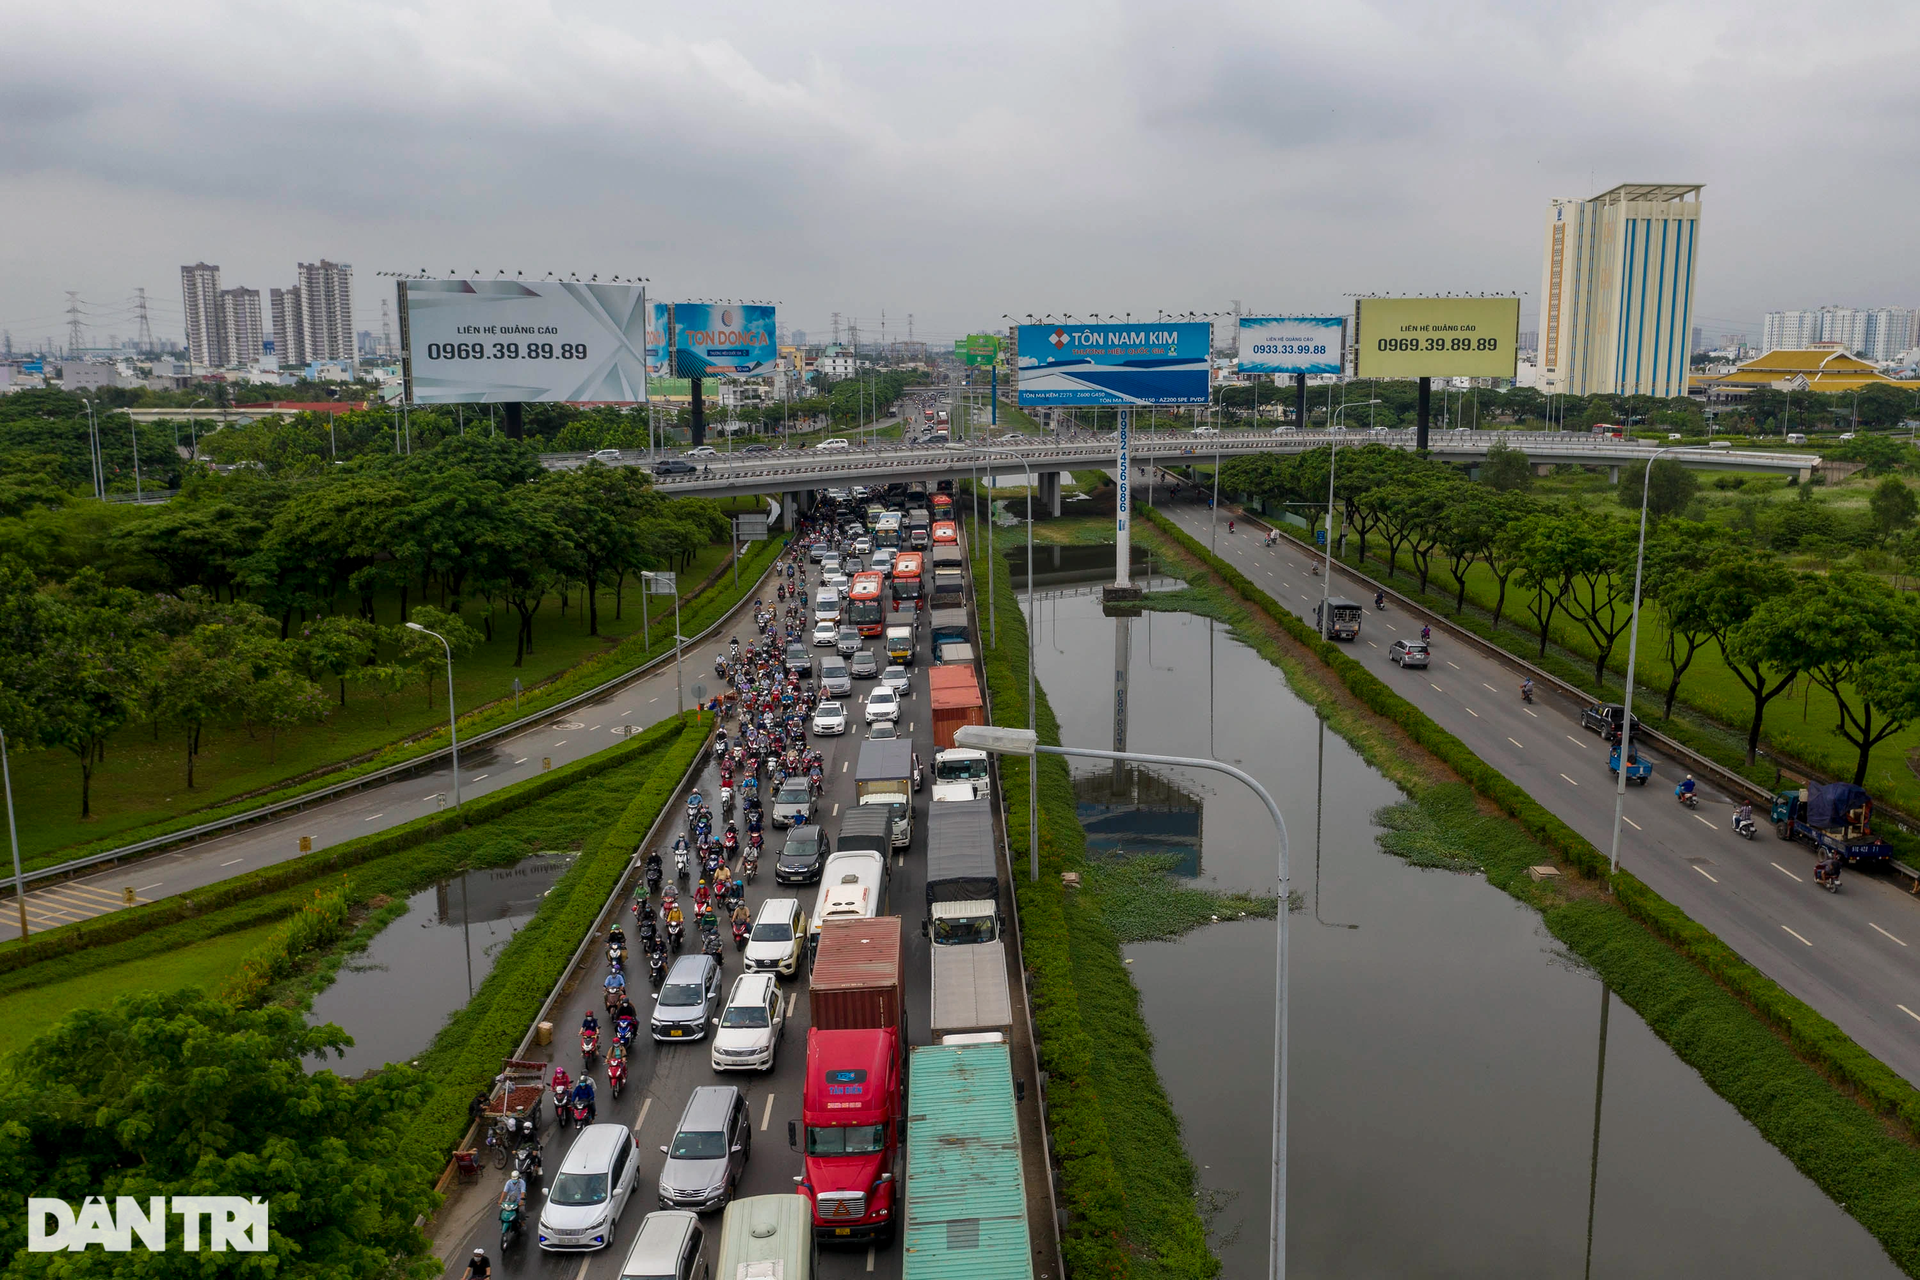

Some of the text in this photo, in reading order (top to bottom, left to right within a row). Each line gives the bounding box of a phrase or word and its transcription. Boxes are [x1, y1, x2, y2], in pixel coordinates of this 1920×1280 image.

[457, 324, 558, 335] LIÊN HỆ QUẢNG CÁO
[686, 330, 768, 346] TON DONG A
[1072, 329, 1178, 346] TÔN NAM KIM
[1378, 338, 1497, 351] 0969.39.89.89
[427, 343, 587, 360] 0969.39.89.89
[1253, 345, 1326, 354] 0933.33.99.88
